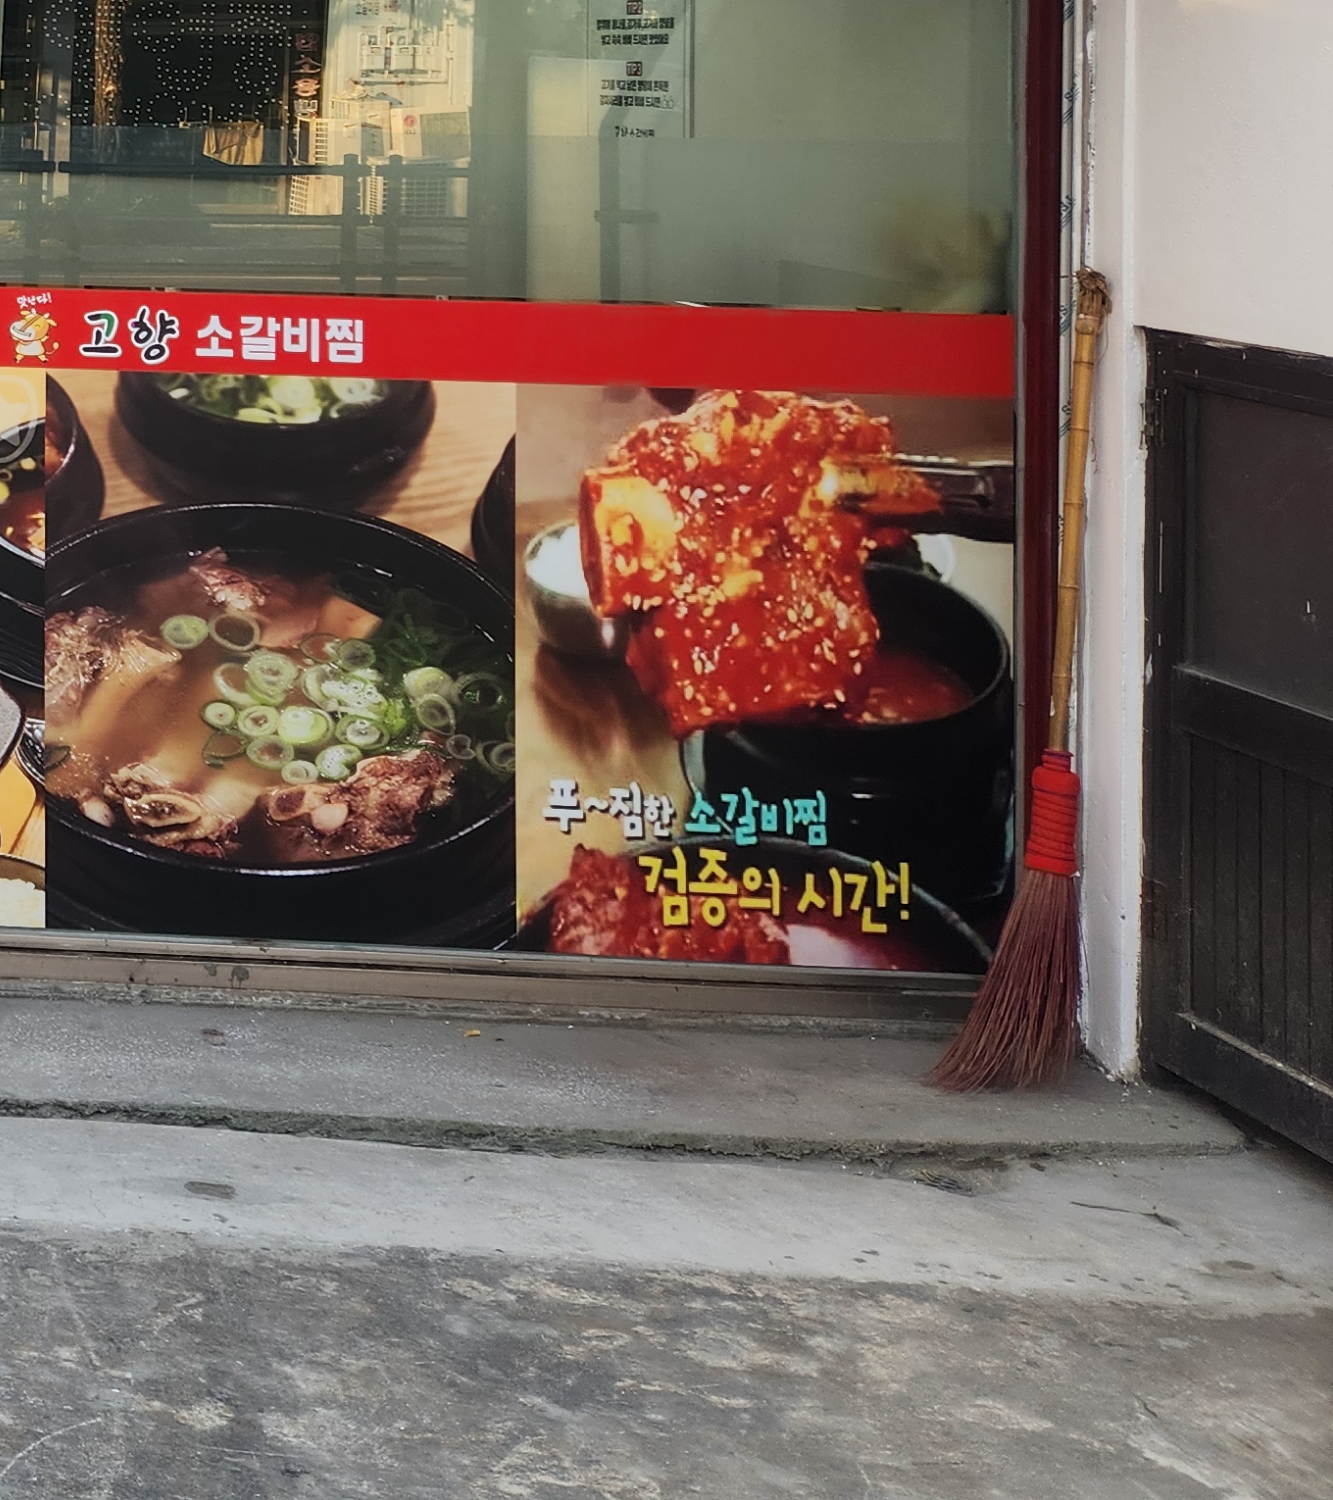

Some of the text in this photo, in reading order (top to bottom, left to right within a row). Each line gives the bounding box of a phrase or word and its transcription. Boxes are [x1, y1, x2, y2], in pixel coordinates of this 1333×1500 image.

[79, 305, 364, 366] 고향 소갈비찜
[684, 788, 828, 846] 소갈비찜
[638, 848, 910, 933] 검증의 시간!
